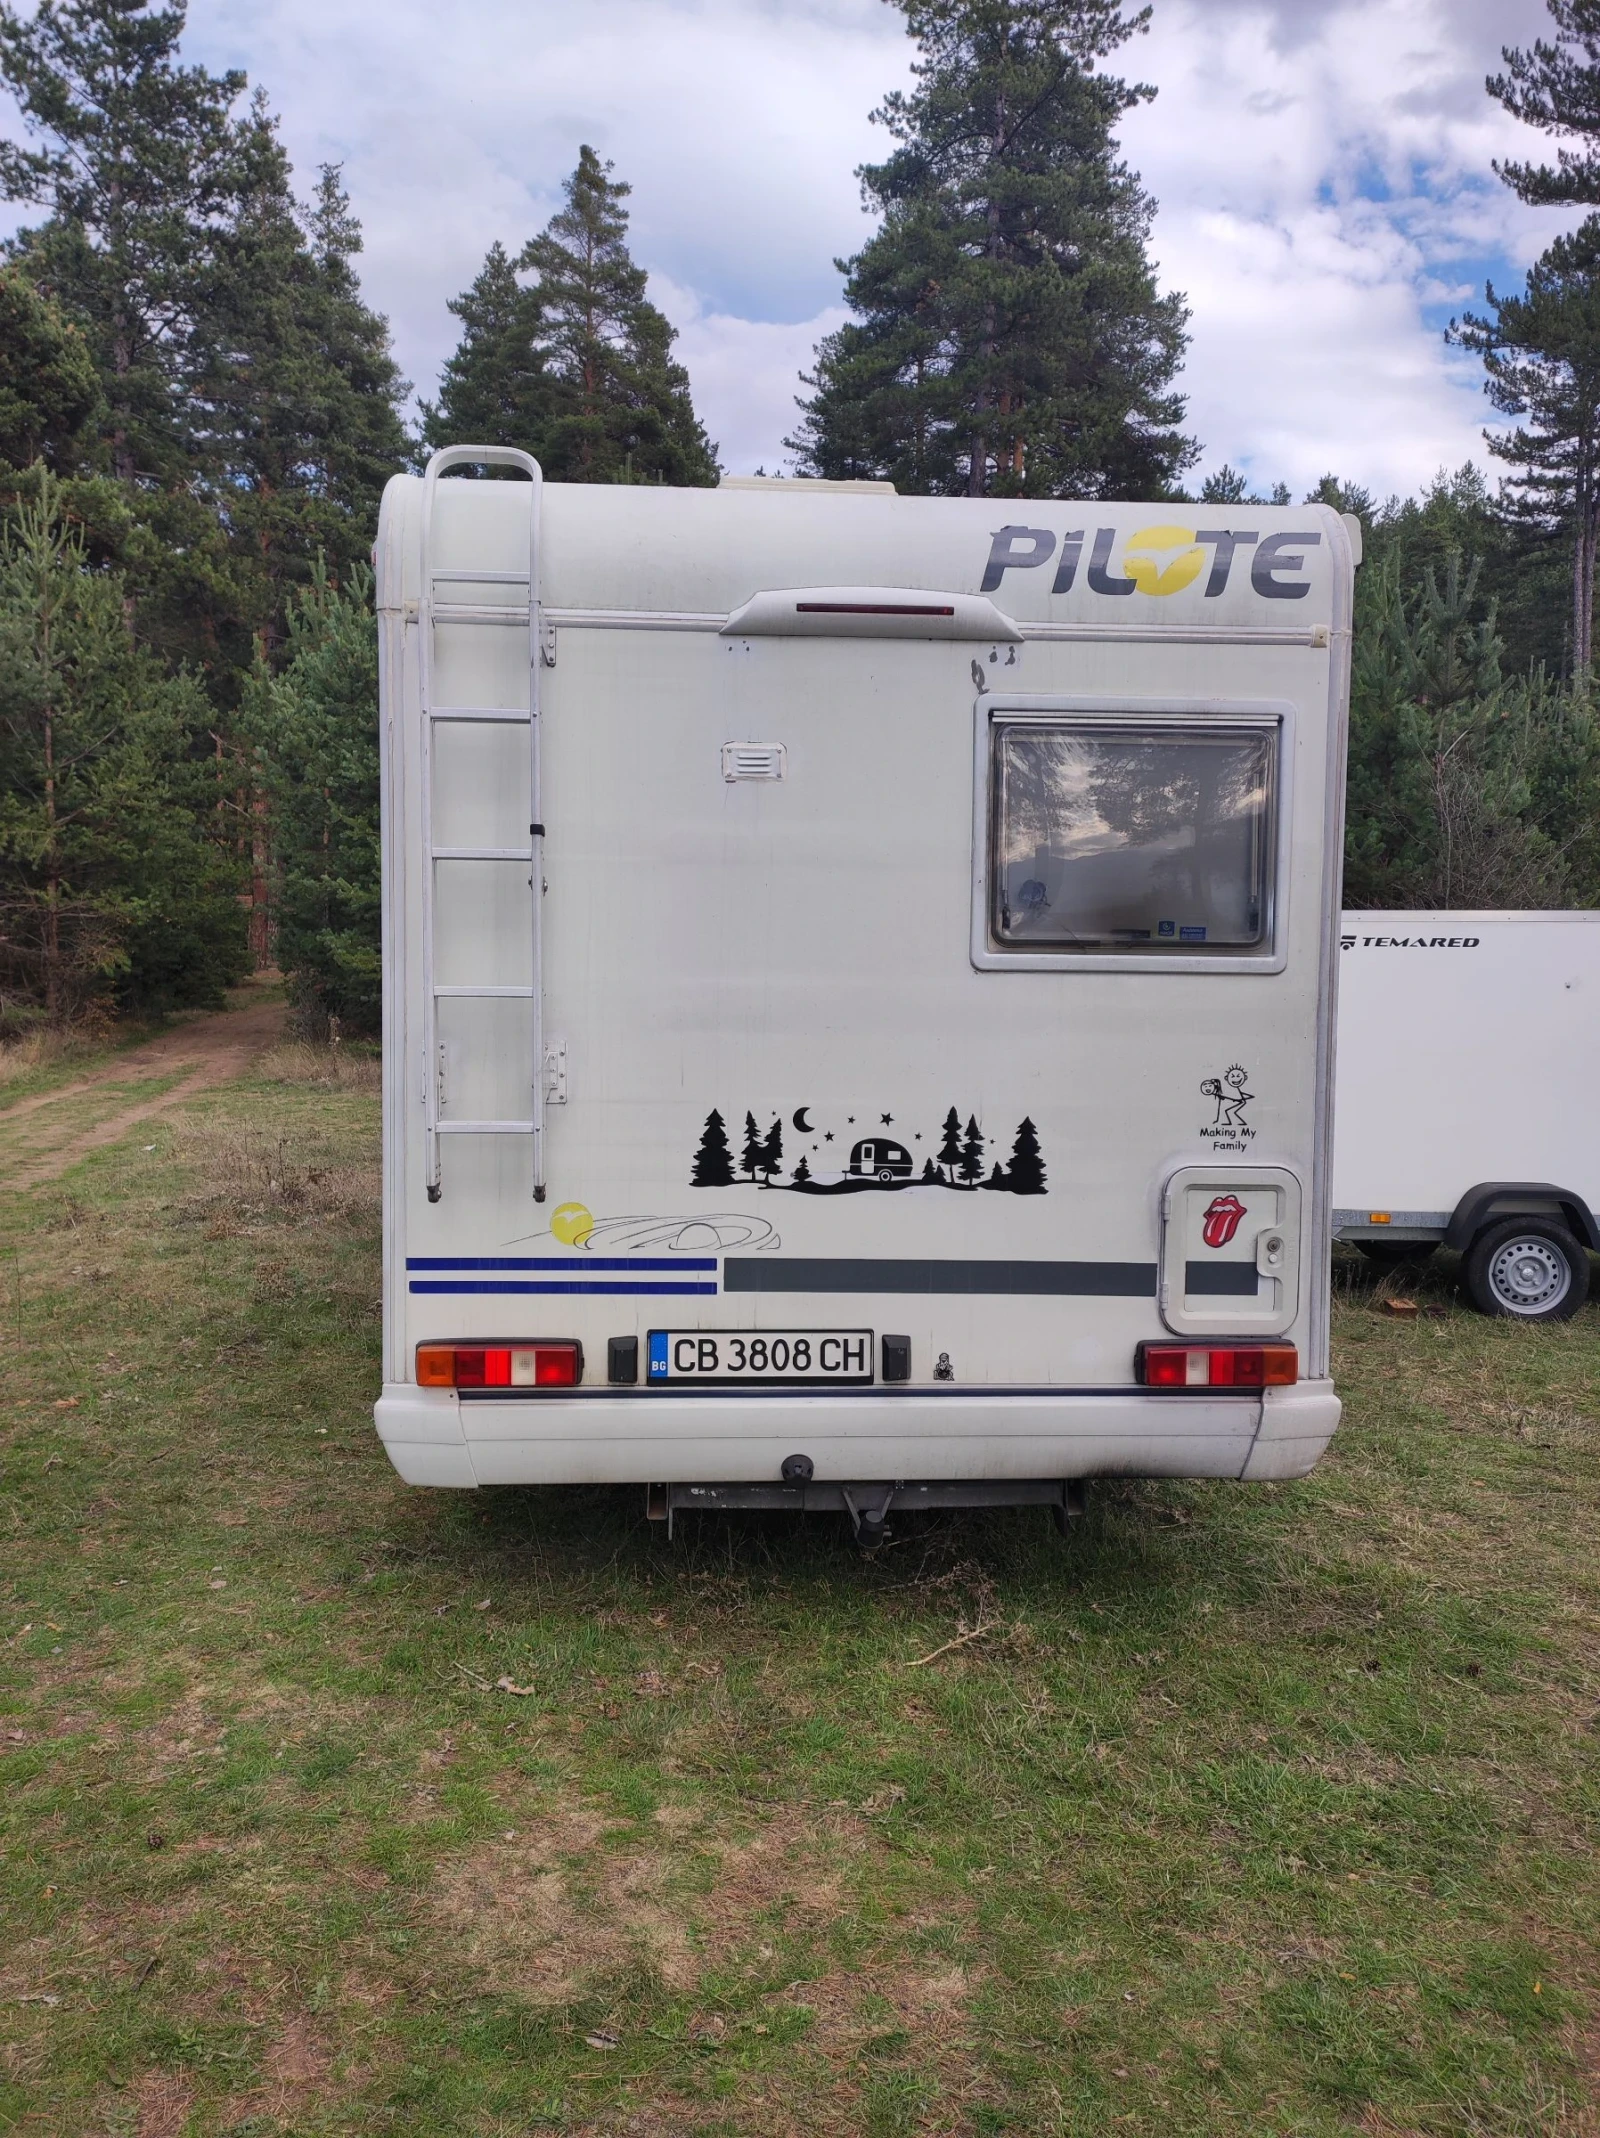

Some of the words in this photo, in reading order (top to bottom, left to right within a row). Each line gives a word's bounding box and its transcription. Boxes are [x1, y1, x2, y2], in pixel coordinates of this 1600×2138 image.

[1362, 937, 1480, 948] TEMARED
[1200, 1127, 1236, 1140] Making
[1241, 1127, 1257, 1139] My
[1213, 1140, 1247, 1152] Family
[651, 1361, 666, 1371] BG
[674, 1338, 718, 1371] CB
[727, 1338, 812, 1371] 3808
[819, 1338, 865, 1371] CH
